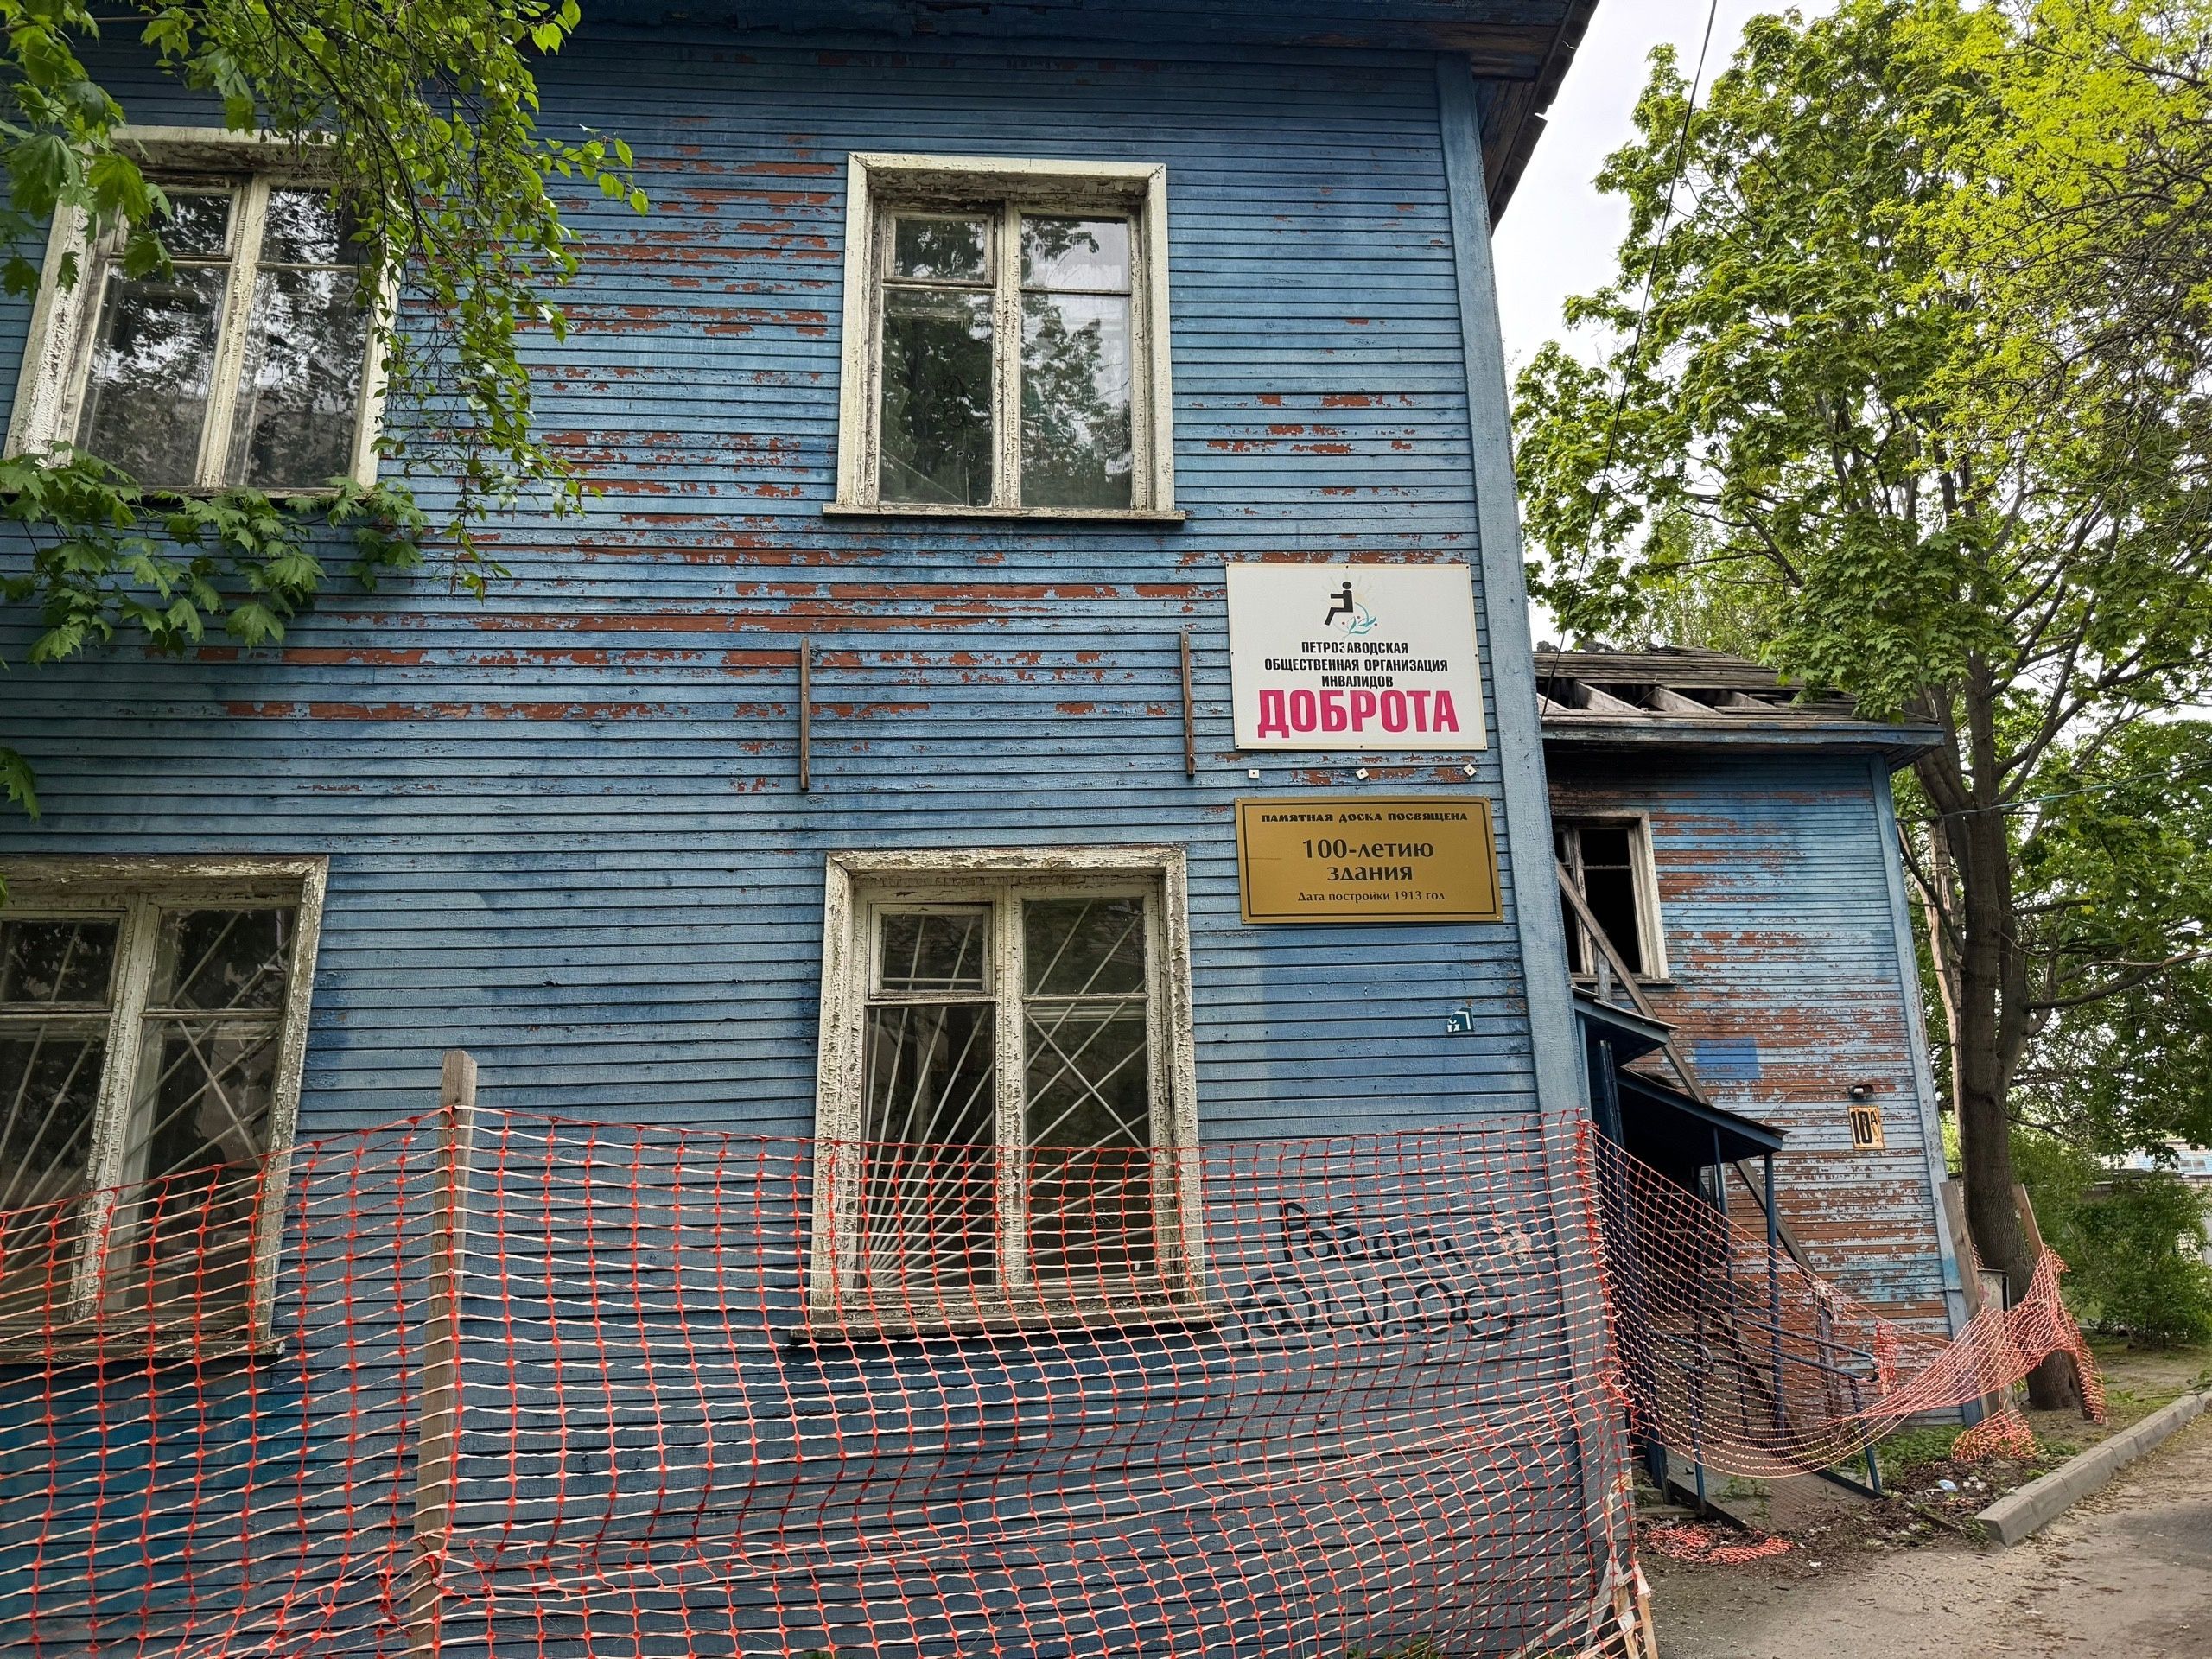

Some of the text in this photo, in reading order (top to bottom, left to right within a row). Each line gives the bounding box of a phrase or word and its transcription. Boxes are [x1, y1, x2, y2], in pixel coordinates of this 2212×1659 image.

[1301, 641, 1408, 654] ПЕТРОЗАВОДСКАЯ
[1264, 658, 1448, 672] ОБЩЕСТВЕННАЯ ОРГАНИЗАЦИЯ
[1321, 675, 1394, 688] ИНВАЛИДОВ
[1257, 690, 1459, 739] ДОБРОТА
[1261, 812, 1468, 823] ПАМЯТНАЯ ДОСКА ПОСВЯЩЕНА
[1302, 839, 1434, 859] 100-летию
[1326, 866, 1413, 881] здания
[1298, 891, 1446, 904] Дата постройки 1913 год
